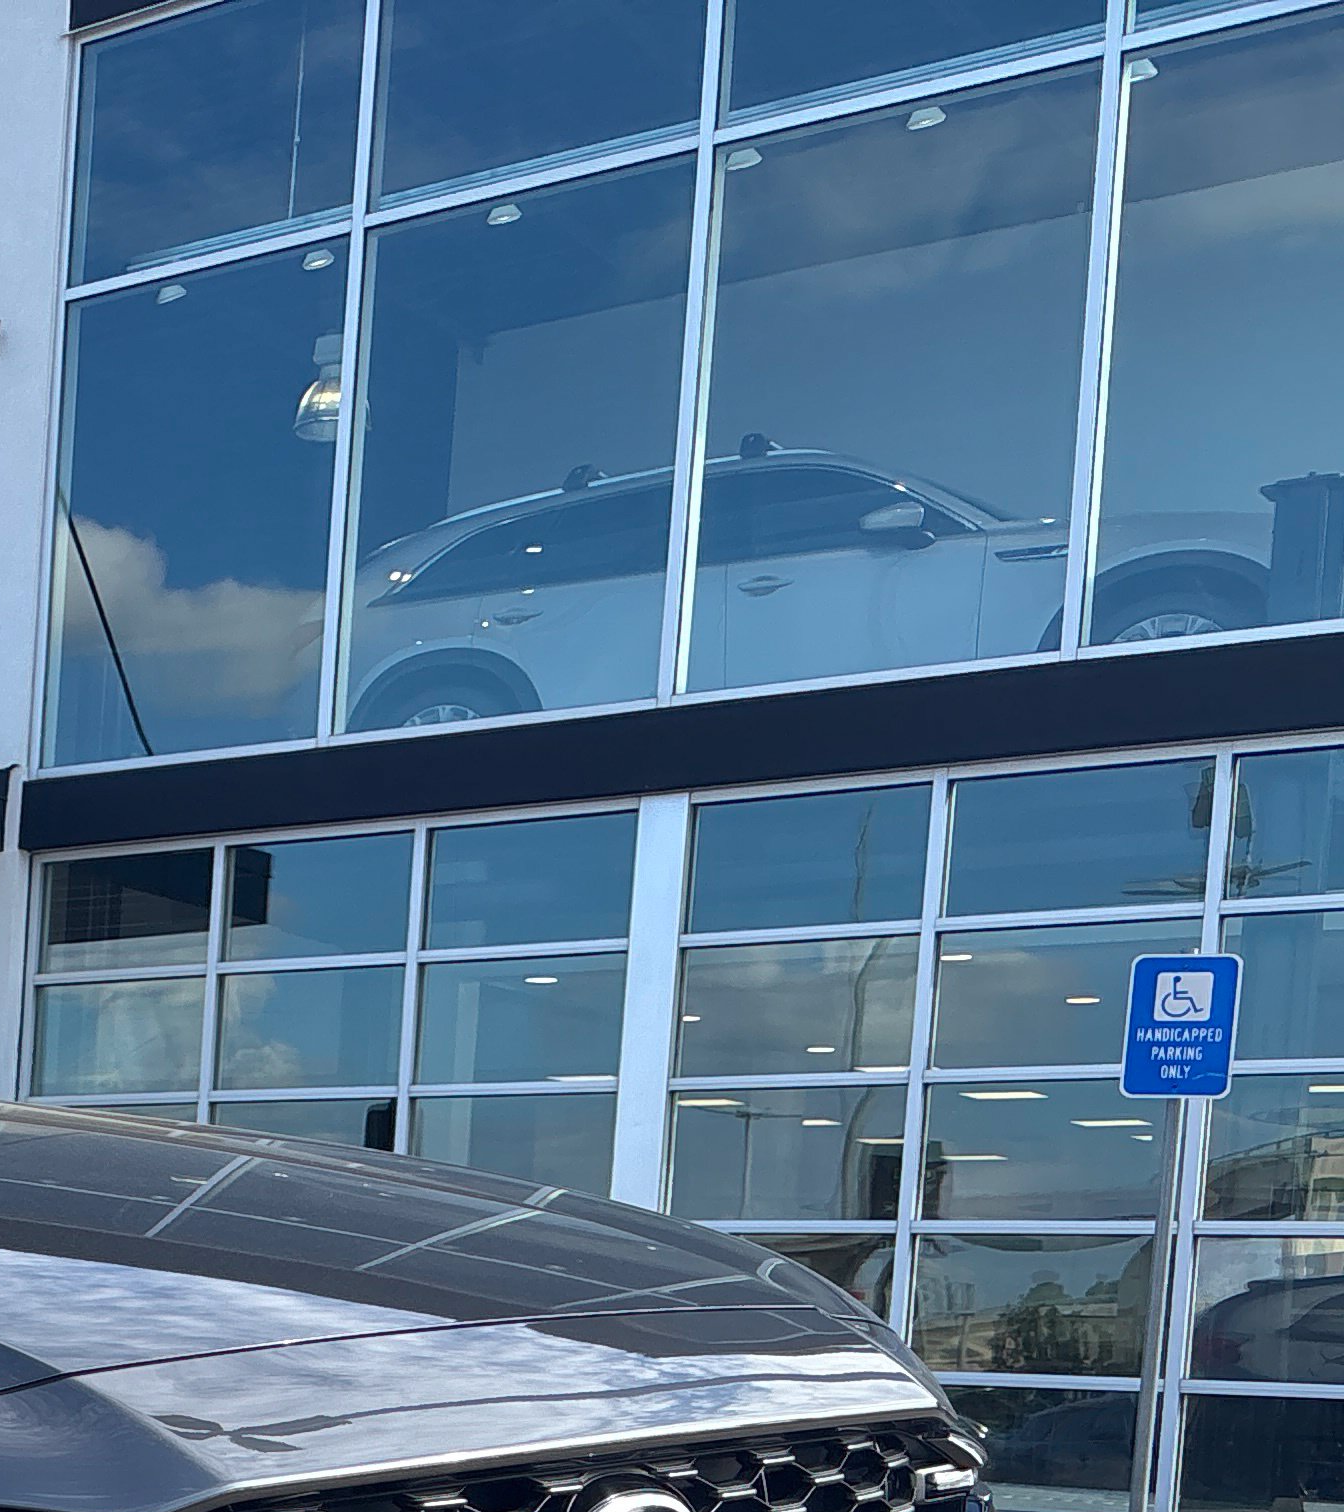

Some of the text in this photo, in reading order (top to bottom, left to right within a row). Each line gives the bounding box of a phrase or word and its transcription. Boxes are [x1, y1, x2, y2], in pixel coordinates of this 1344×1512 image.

[1136, 1027, 1223, 1042] HANDICAPPED
[1150, 1046, 1203, 1061] PARKING
[1160, 1065, 1191, 1079] ONLY
